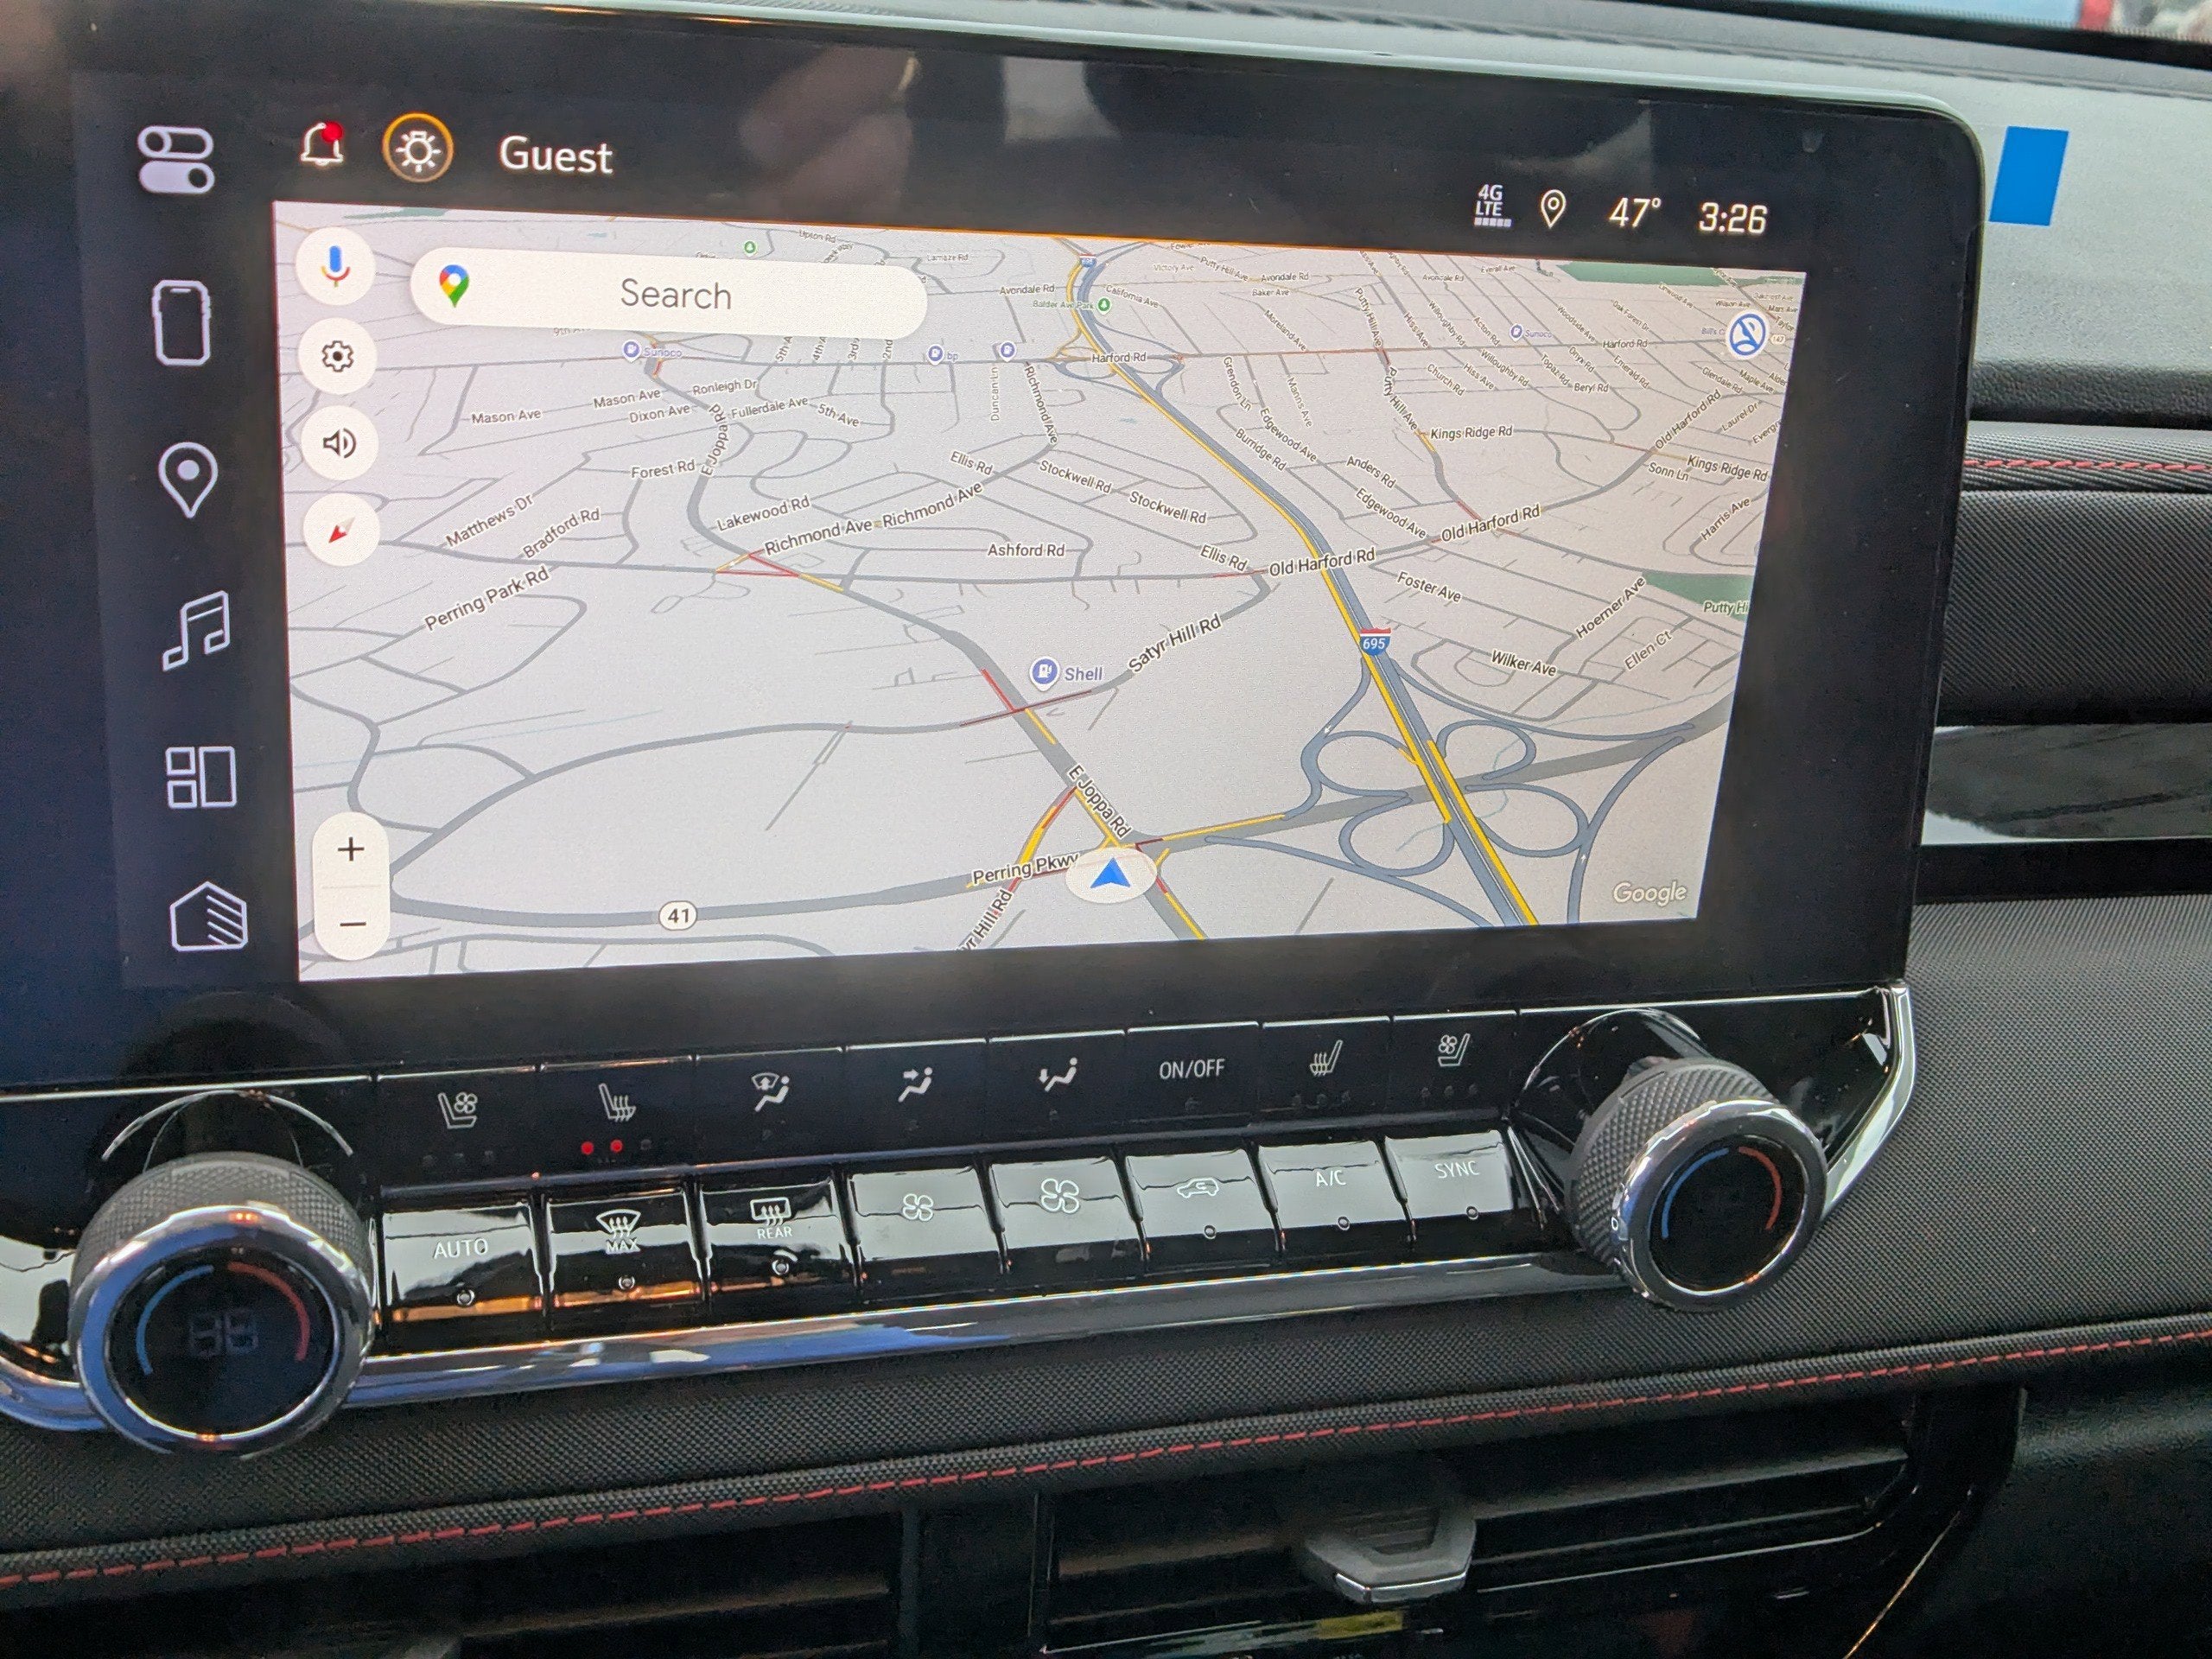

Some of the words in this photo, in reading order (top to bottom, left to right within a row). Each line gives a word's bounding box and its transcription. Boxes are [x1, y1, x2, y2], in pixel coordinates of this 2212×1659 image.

[499, 135, 613, 174] Guest
[1478, 184, 1503, 200] 4G
[1476, 201, 1503, 216] LTE
[1609, 197, 1662, 228] 47°
[1700, 202, 1768, 234] 3:26
[1000, 285, 1040, 295] Avondale
[1262, 274, 1296, 283] Avondale
[620, 276, 733, 310] Search
[1107, 285, 1142, 302] California
[1143, 296, 1159, 308] Ave
[1356, 288, 1370, 312] Putty
[1264, 309, 1295, 339] Moreland
[1294, 336, 1306, 351] Ave
[1404, 313, 1417, 333] Hiss
[1416, 331, 1429, 347] Ave
[1429, 301, 1459, 340] Willoughby
[1473, 316, 1491, 340] Acton
[1557, 306, 1585, 334] Woodside
[1584, 329, 1596, 342] Ave
[644, 347, 683, 357] Sunoco
[882, 340, 893, 359] 2nd
[947, 352, 958, 360] bp
[1603, 340, 1634, 348] Harford
[1092, 353, 1130, 363] Harford
[1133, 353, 1147, 361] Rd
[1480, 350, 1516, 380] Willoughby
[1518, 375, 1529, 386] Rd
[1541, 354, 1559, 376] Topaz
[1559, 372, 1569, 385] Rd
[1614, 355, 1637, 380] Emerald
[693, 380, 738, 395] Ronleigh
[741, 378, 758, 390] Dr
[1224, 357, 1243, 400] Grendon
[1240, 398, 1252, 412] Ln
[1427, 364, 1452, 388] Church
[1452, 385, 1465, 396] Rd
[1463, 364, 1478, 378] Hiss
[1480, 377, 1494, 390] Ave
[1702, 367, 1730, 388] Glendale
[1732, 383, 1743, 394] Rd
[1739, 369, 1759, 386] Maple
[1760, 381, 1774, 393] Ave
[594, 394, 635, 409] Mason
[640, 390, 661, 399] Ave
[731, 401, 786, 419] Fullerdale
[788, 397, 809, 409] Ave
[1024, 365, 1051, 421] Richmond
[1044, 420, 1058, 444] Ave
[1383, 366, 1398, 397] Putty
[1402, 411, 1418, 429] Ave
[472, 413, 514, 423] Mason
[518, 410, 542, 420] Ave
[629, 410, 664, 423] Dixon
[668, 404, 690, 416] Ave
[818, 404, 836, 416] 5th
[839, 413, 859, 427] Ave
[1302, 409, 1313, 427] Ave
[1656, 434, 1672, 450] Old
[1671, 402, 1710, 435] Harford
[1705, 389, 1721, 406] Rd
[1721, 408, 1748, 432] Laurel
[1747, 401, 1758, 413] Dr
[1261, 408, 1300, 449] Edgewood
[1300, 445, 1317, 461] Ave
[1431, 429, 1461, 442] Kings
[1465, 428, 1495, 439] Ridge
[1499, 426, 1512, 436] Rd
[702, 465, 713, 476] E
[709, 424, 730, 465] Joppa
[950, 451, 974, 468] Ellis
[976, 461, 994, 476] Rd
[1236, 429, 1273, 460] Burridge
[1272, 457, 1287, 471] Rd
[632, 462, 676, 479] Forest
[680, 460, 695, 473] Rd
[1039, 461, 1095, 488] Stockwell
[1096, 480, 1112, 494] Rd
[1347, 456, 1382, 476] Anders
[1382, 474, 1395, 488] Rd
[1648, 462, 1674, 478] Sonn
[1676, 470, 1688, 481] Ln
[1688, 454, 1717, 473] Kings
[1721, 463, 1752, 479] Ridge
[1754, 470, 1769, 481] Rd
[717, 501, 788, 531] Lakewood
[791, 495, 810, 511] Rd
[883, 499, 954, 527] Richmond
[957, 482, 982, 503] Ave
[1129, 492, 1189, 520] Stockwell
[1190, 509, 1207, 524] Rd
[1357, 488, 1407, 528] Edgewood
[1407, 522, 1426, 538] Ave
[446, 505, 514, 548] Matthews
[515, 493, 533, 511] Dr
[1442, 528, 1465, 541] Old
[1468, 513, 1519, 535] Harford
[1522, 505, 1540, 518] Rd
[1700, 512, 1732, 541] Harris
[1732, 497, 1750, 514] Ave
[523, 518, 579, 559] Bradford
[581, 508, 600, 524] Rd
[765, 524, 840, 556] Richmond
[845, 519, 873, 535] Ave
[988, 543, 1042, 557] Ashford
[1046, 544, 1065, 556] Rd
[1200, 545, 1227, 563] Ellis
[1229, 556, 1248, 572] Rd
[1270, 563, 1294, 576] Old
[1298, 552, 1352, 572] Harford
[1356, 547, 1376, 562] Rd
[424, 597, 485, 631] Perring
[486, 579, 524, 605] Park
[525, 566, 550, 587] Rd
[1397, 572, 1436, 594] Foster
[1438, 587, 1461, 602] Ave
[1624, 576, 1645, 599] Ave
[1704, 602, 1734, 616] Putty
[1129, 639, 1166, 672] Satyr
[1169, 622, 1196, 646] Hill
[1199, 613, 1221, 635] Rd
[1363, 638, 1385, 650] 695
[1624, 645, 1656, 670] Ellen
[1656, 630, 1671, 645] Ct
[1065, 667, 1103, 681] Shell
[1491, 650, 1528, 669] Wilker
[1532, 661, 1556, 676] Ave
[1068, 766, 1084, 780] E
[1078, 779, 1115, 820] Joppa
[1109, 817, 1131, 838] Rd
[972, 861, 1032, 886] Perring
[1613, 880, 1687, 907] Google
[667, 908, 690, 923] 41
[974, 912, 999, 938] Hill
[990, 888, 1013, 914] Rd
[1160, 1058, 1224, 1079] ON/OFF
[1316, 1170, 1345, 1186] A/C
[1435, 1161, 1479, 1178] SYNC
[606, 1239, 639, 1252] MAX
[757, 1227, 791, 1239] REAR
[434, 1239, 488, 1259] AUTO
